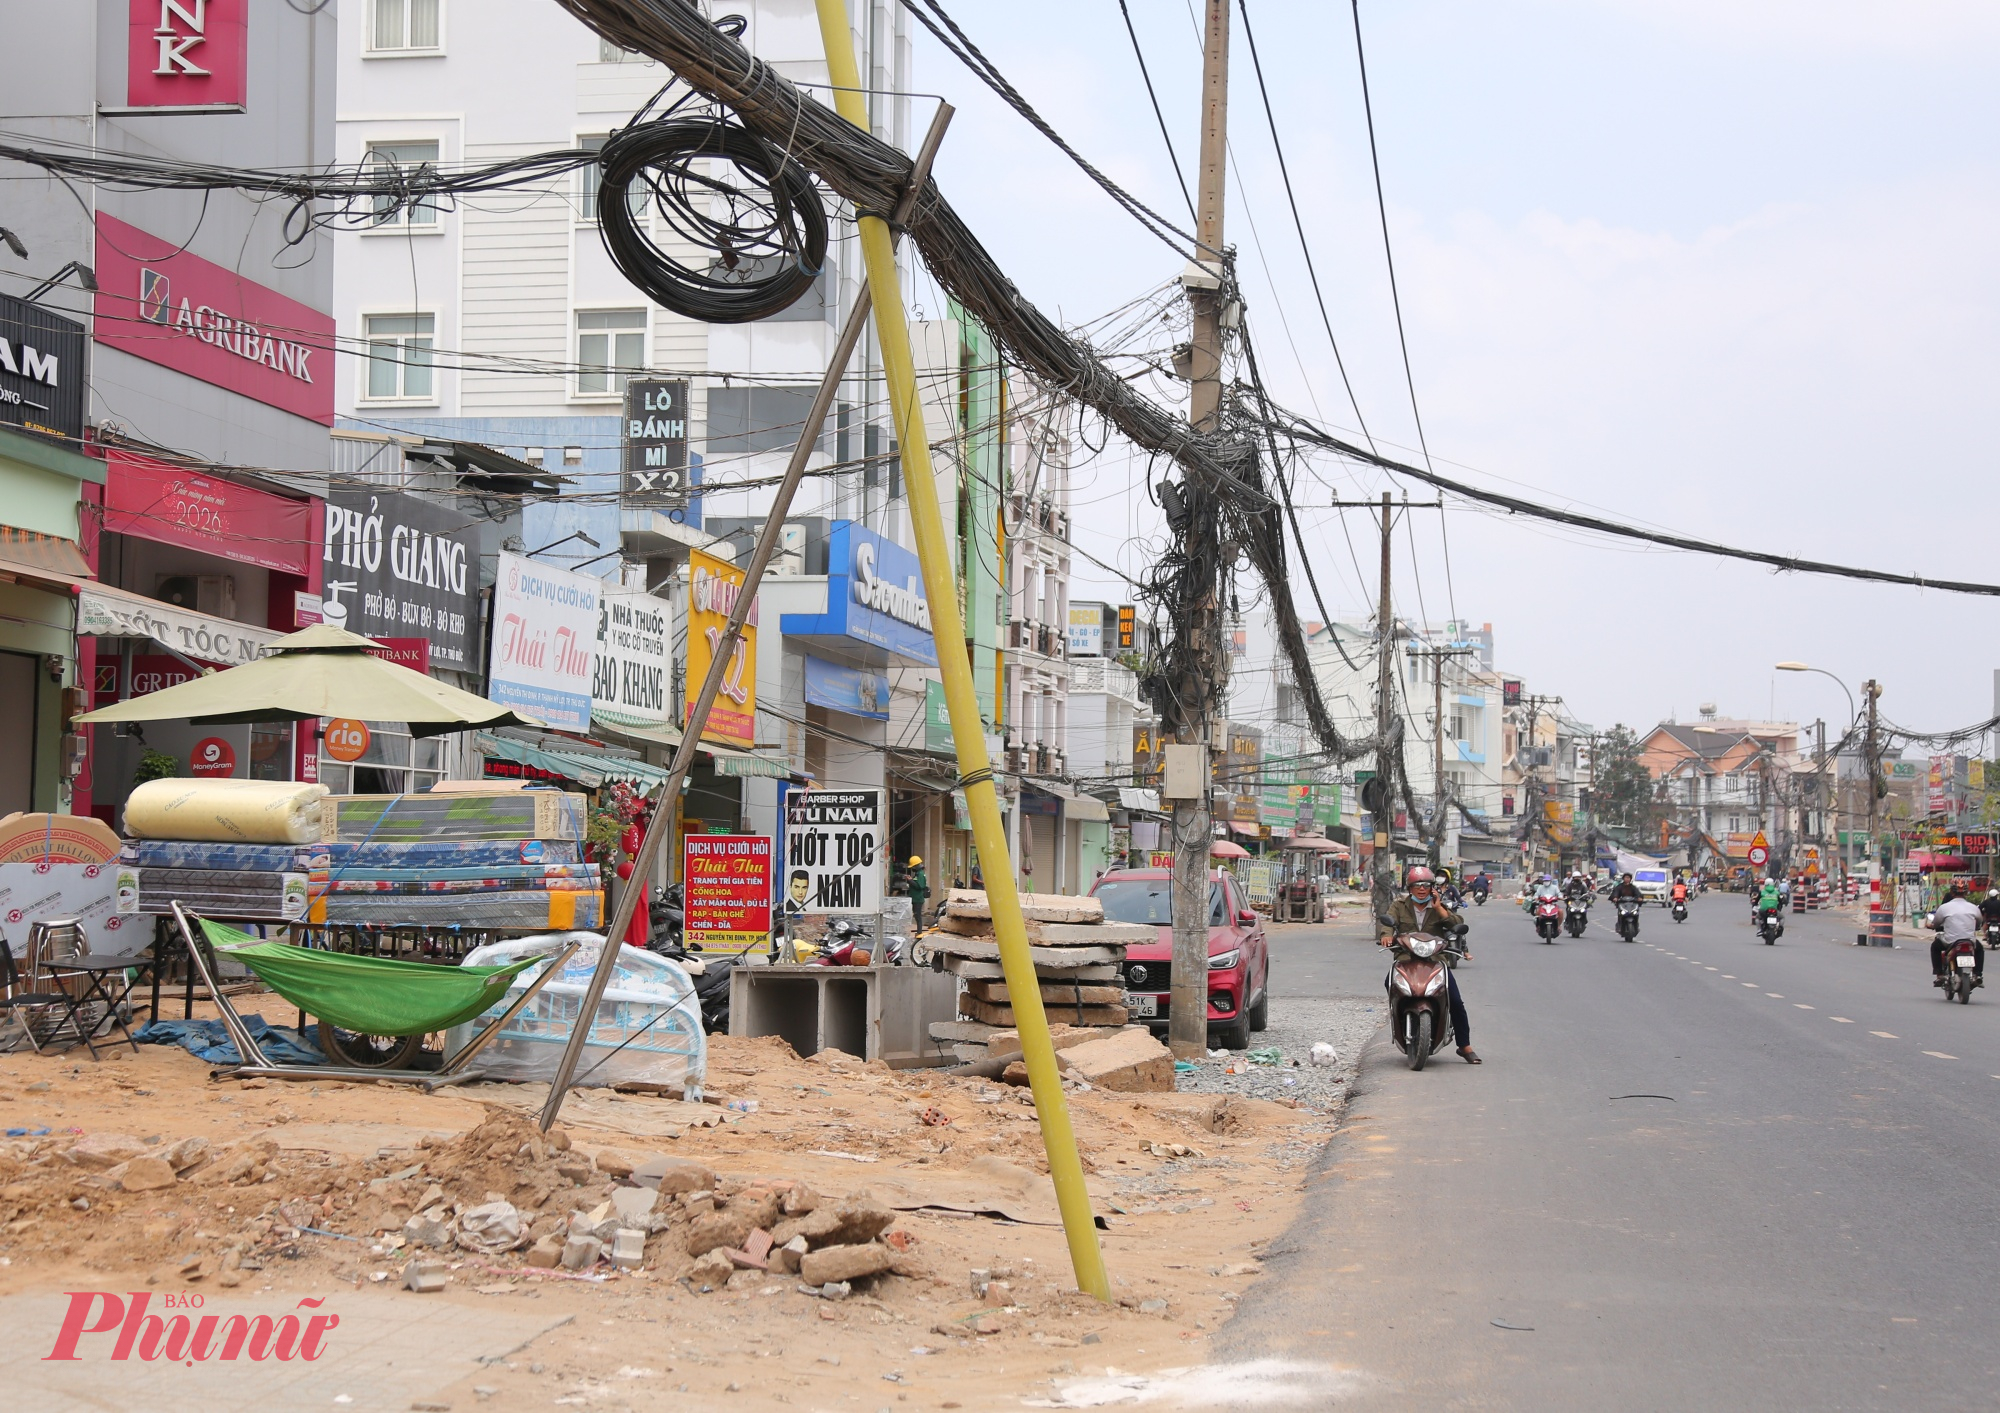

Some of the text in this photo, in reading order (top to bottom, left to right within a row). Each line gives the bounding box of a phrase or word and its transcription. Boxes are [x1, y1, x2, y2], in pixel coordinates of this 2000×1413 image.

[172, 297, 313, 384] AGRIBANK
[644, 387, 672, 411] LÒ
[629, 414, 684, 439] BÁNH
[645, 444, 668, 466] MÌ
[631, 470, 681, 498] X2
[176, 501, 222, 533] 2026
[323, 496, 468, 597] PHỞ GIANG
[521, 574, 595, 612] DỊCH VỤ CƯỚI HỎI
[364, 590, 383, 616] PHỞ
[384, 594, 396, 620] BÒ
[420, 603, 432, 628] BÒ
[437, 607, 448, 632] BÒ
[449, 612, 465, 636] KHO
[612, 602, 664, 635] NHÀ THUỐC
[1069, 609, 1100, 625] DECAL
[177, 622, 232, 651] TÓC
[502, 612, 589, 678] Thái Thu
[618, 632, 631, 652] HỌC
[622, 660, 663, 711] KHANG
[330, 723, 362, 747] ria
[192, 761, 233, 772] MoneyGram
[305, 757, 316, 768] 344
[839, 795, 865, 803] SHOP
[826, 808, 873, 822] NAM
[57, 843, 77, 856] HẢI
[688, 840, 768, 856] DỊCH VỤ CƯỚI HỎI
[790, 827, 874, 867] HỚT TÓC
[1964, 836, 1996, 845] BIDA
[692, 858, 765, 873] Thái Thu
[693, 877, 718, 885] TRANG
[719, 876, 731, 885] TRÍ
[746, 876, 763, 885] TIÊN
[817, 874, 861, 907] NAM
[716, 888, 732, 896] HOA
[693, 898, 707, 907] XÂY
[709, 898, 726, 907] MÂM
[692, 911, 707, 919] RẠP
[713, 909, 728, 918] BÀN
[729, 908, 745, 918] GHẾ
[692, 919, 712, 929] CHÉN
[688, 932, 705, 941] 342
[1129, 996, 1146, 1006] 51K
